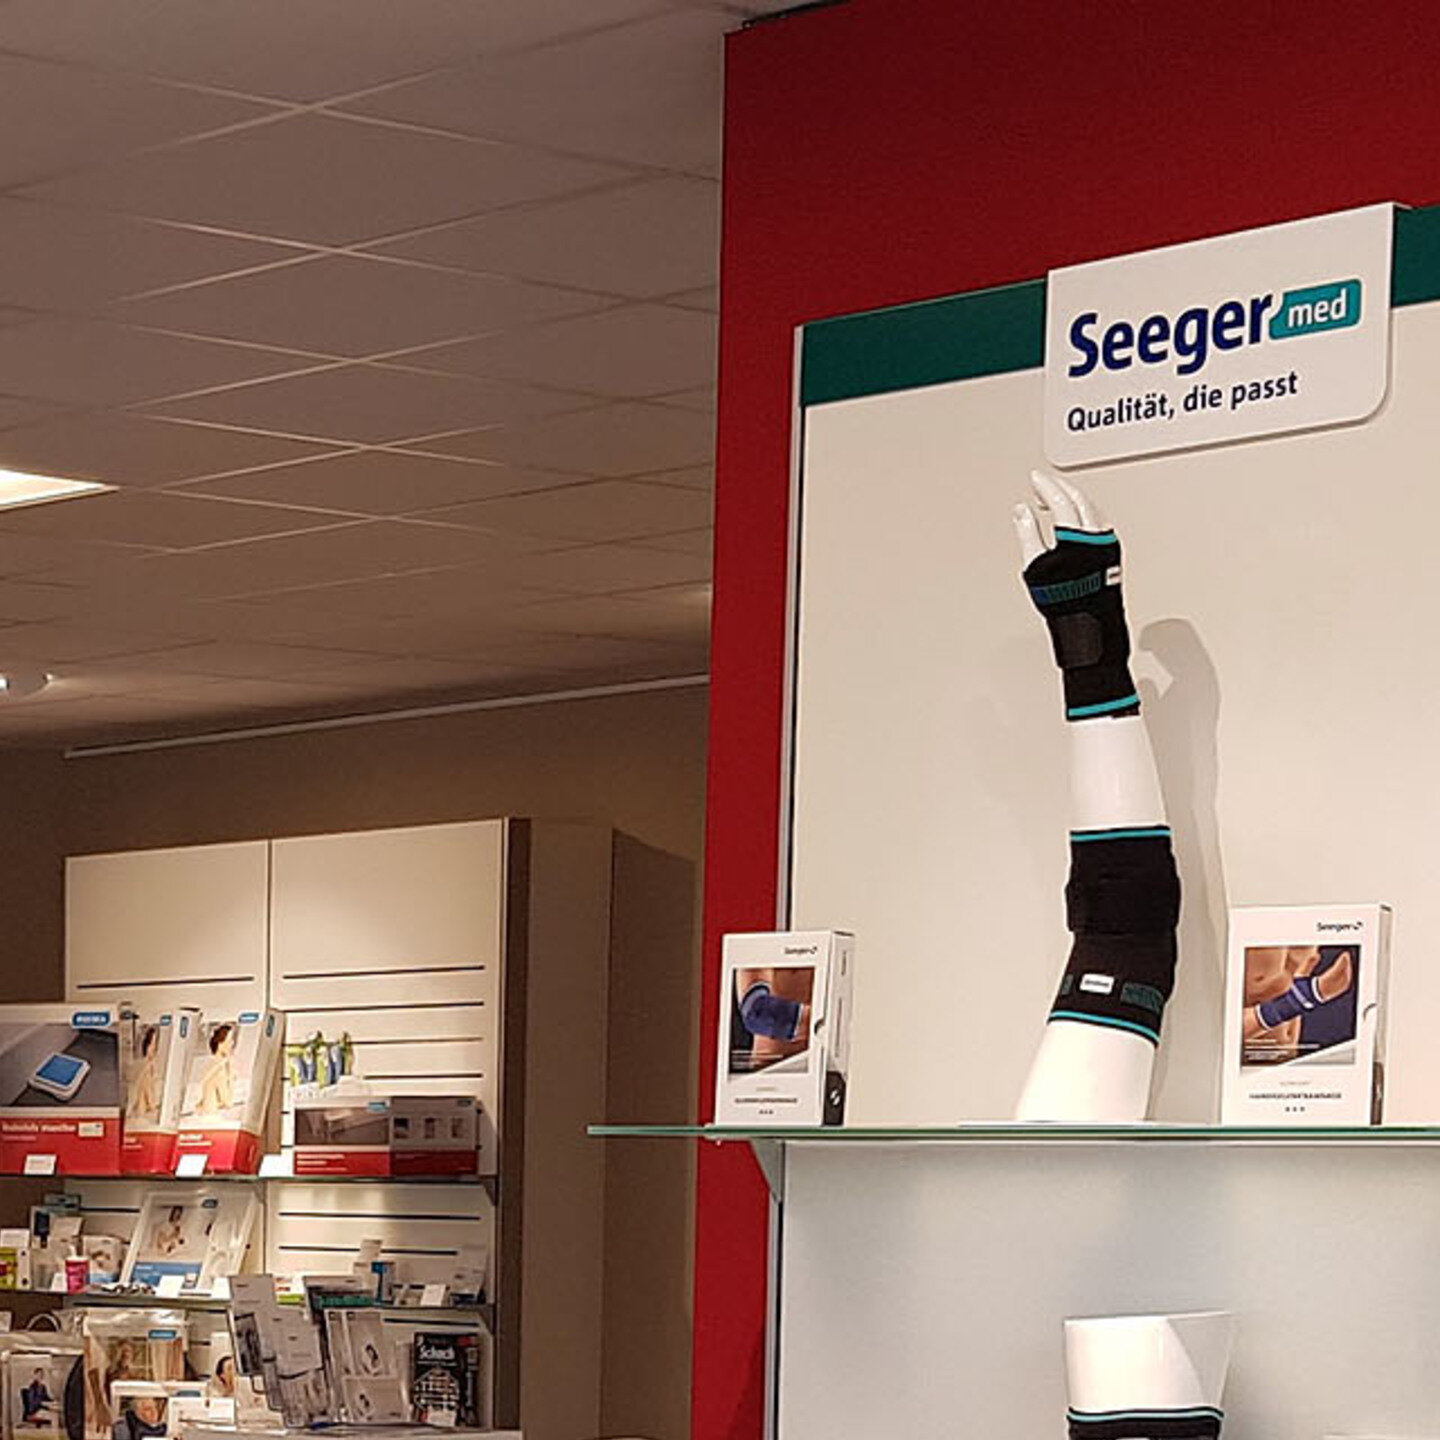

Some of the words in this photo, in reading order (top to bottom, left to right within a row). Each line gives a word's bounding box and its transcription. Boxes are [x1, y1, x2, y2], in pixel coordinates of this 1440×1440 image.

[1068, 294, 1273, 378] Seeger
[1287, 289, 1347, 329] med
[1067, 394, 1175, 432] Qualität,
[1183, 384, 1222, 413] die
[1230, 370, 1298, 411] passt
